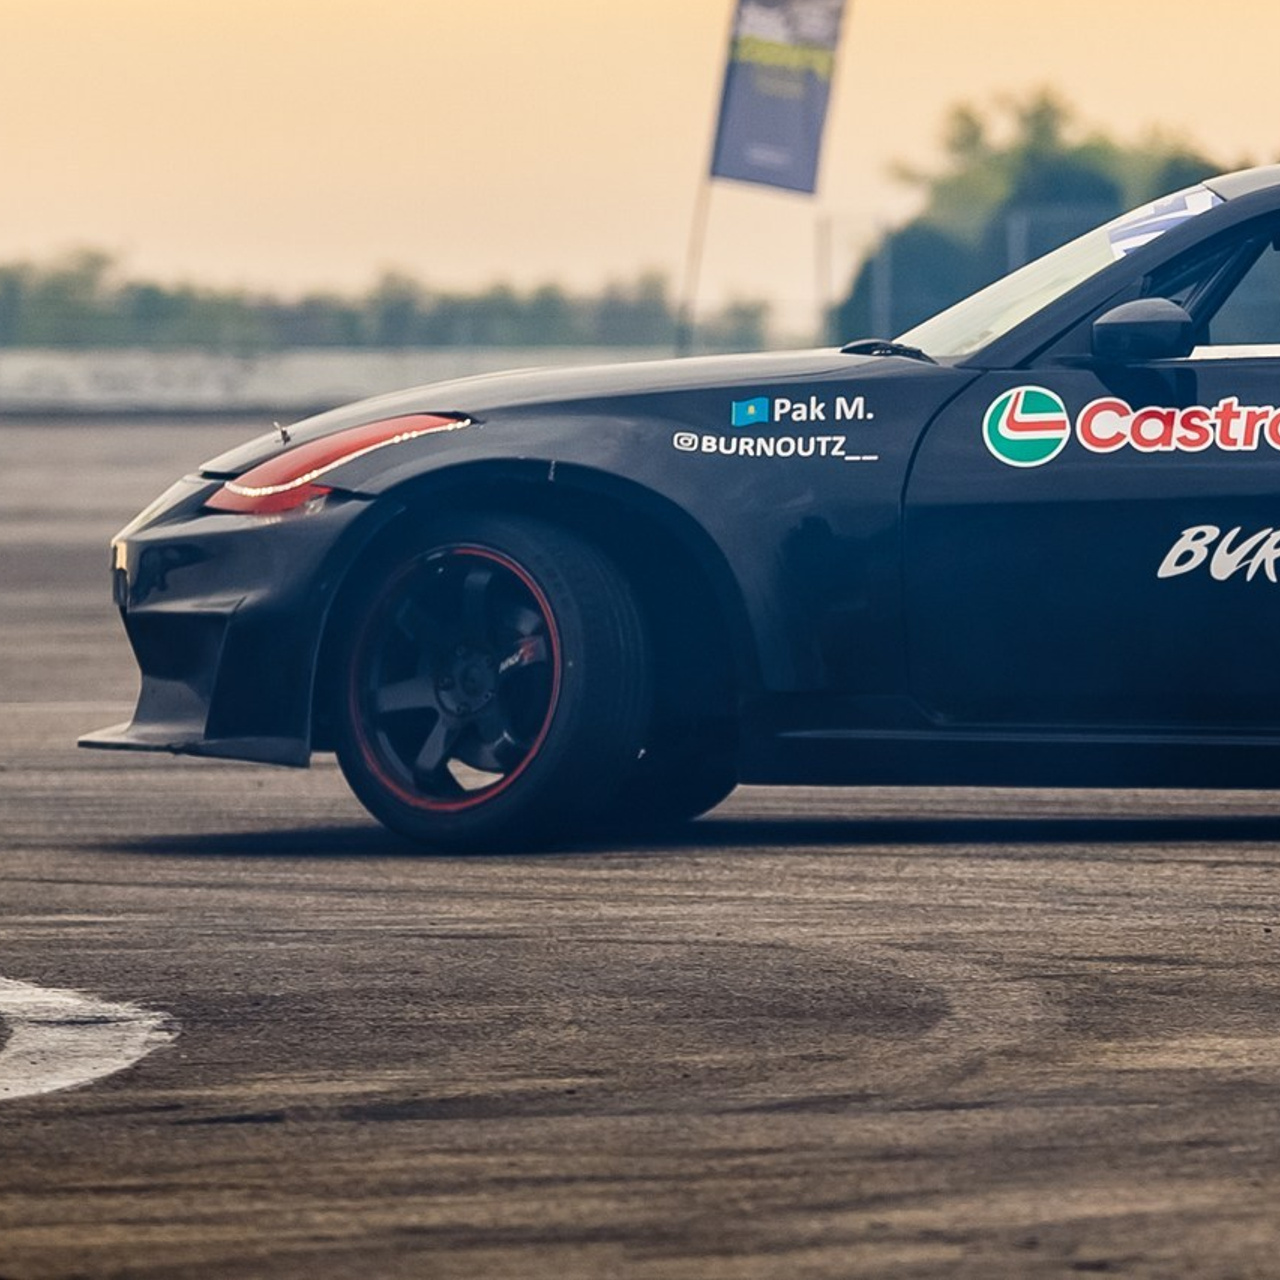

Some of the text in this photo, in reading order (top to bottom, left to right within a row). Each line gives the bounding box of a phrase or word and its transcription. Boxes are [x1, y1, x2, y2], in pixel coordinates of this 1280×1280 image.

[774, 396, 874, 422] Pak M.
[701, 435, 879, 461] BURNOUTZ__
